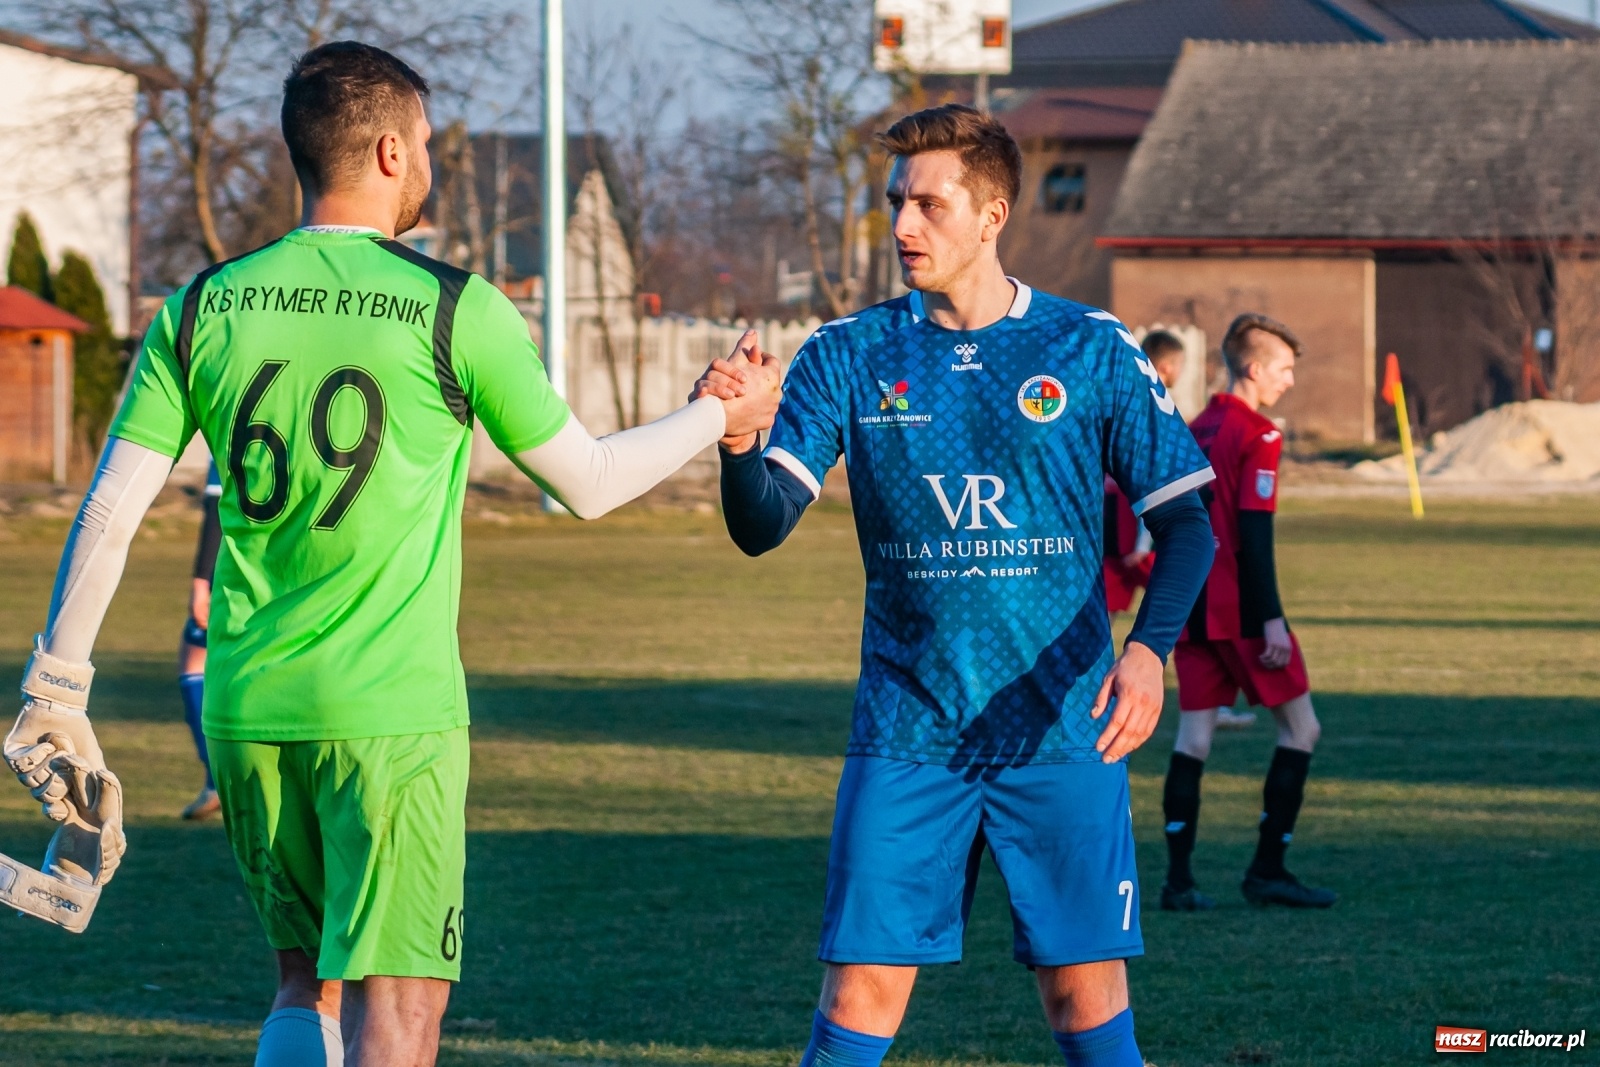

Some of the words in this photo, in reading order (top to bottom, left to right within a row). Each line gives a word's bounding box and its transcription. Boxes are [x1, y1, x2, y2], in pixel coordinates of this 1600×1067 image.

[203, 288, 234, 314] KS
[240, 286, 328, 314] RYMER
[336, 289, 431, 328] RYBNIK
[951, 362, 983, 372] hummel
[859, 416, 881, 424] GMINA
[882, 413, 932, 423] KRZYŻANOWICE
[228, 359, 388, 532] 69
[922, 474, 1018, 530] VR
[878, 542, 933, 559] VILLA
[941, 537, 1075, 558] RUBINSTEIN
[907, 569, 958, 579] BESKIDY
[991, 567, 1039, 577] RESORT
[1118, 880, 1134, 931] 7
[441, 906, 464, 962] 6
